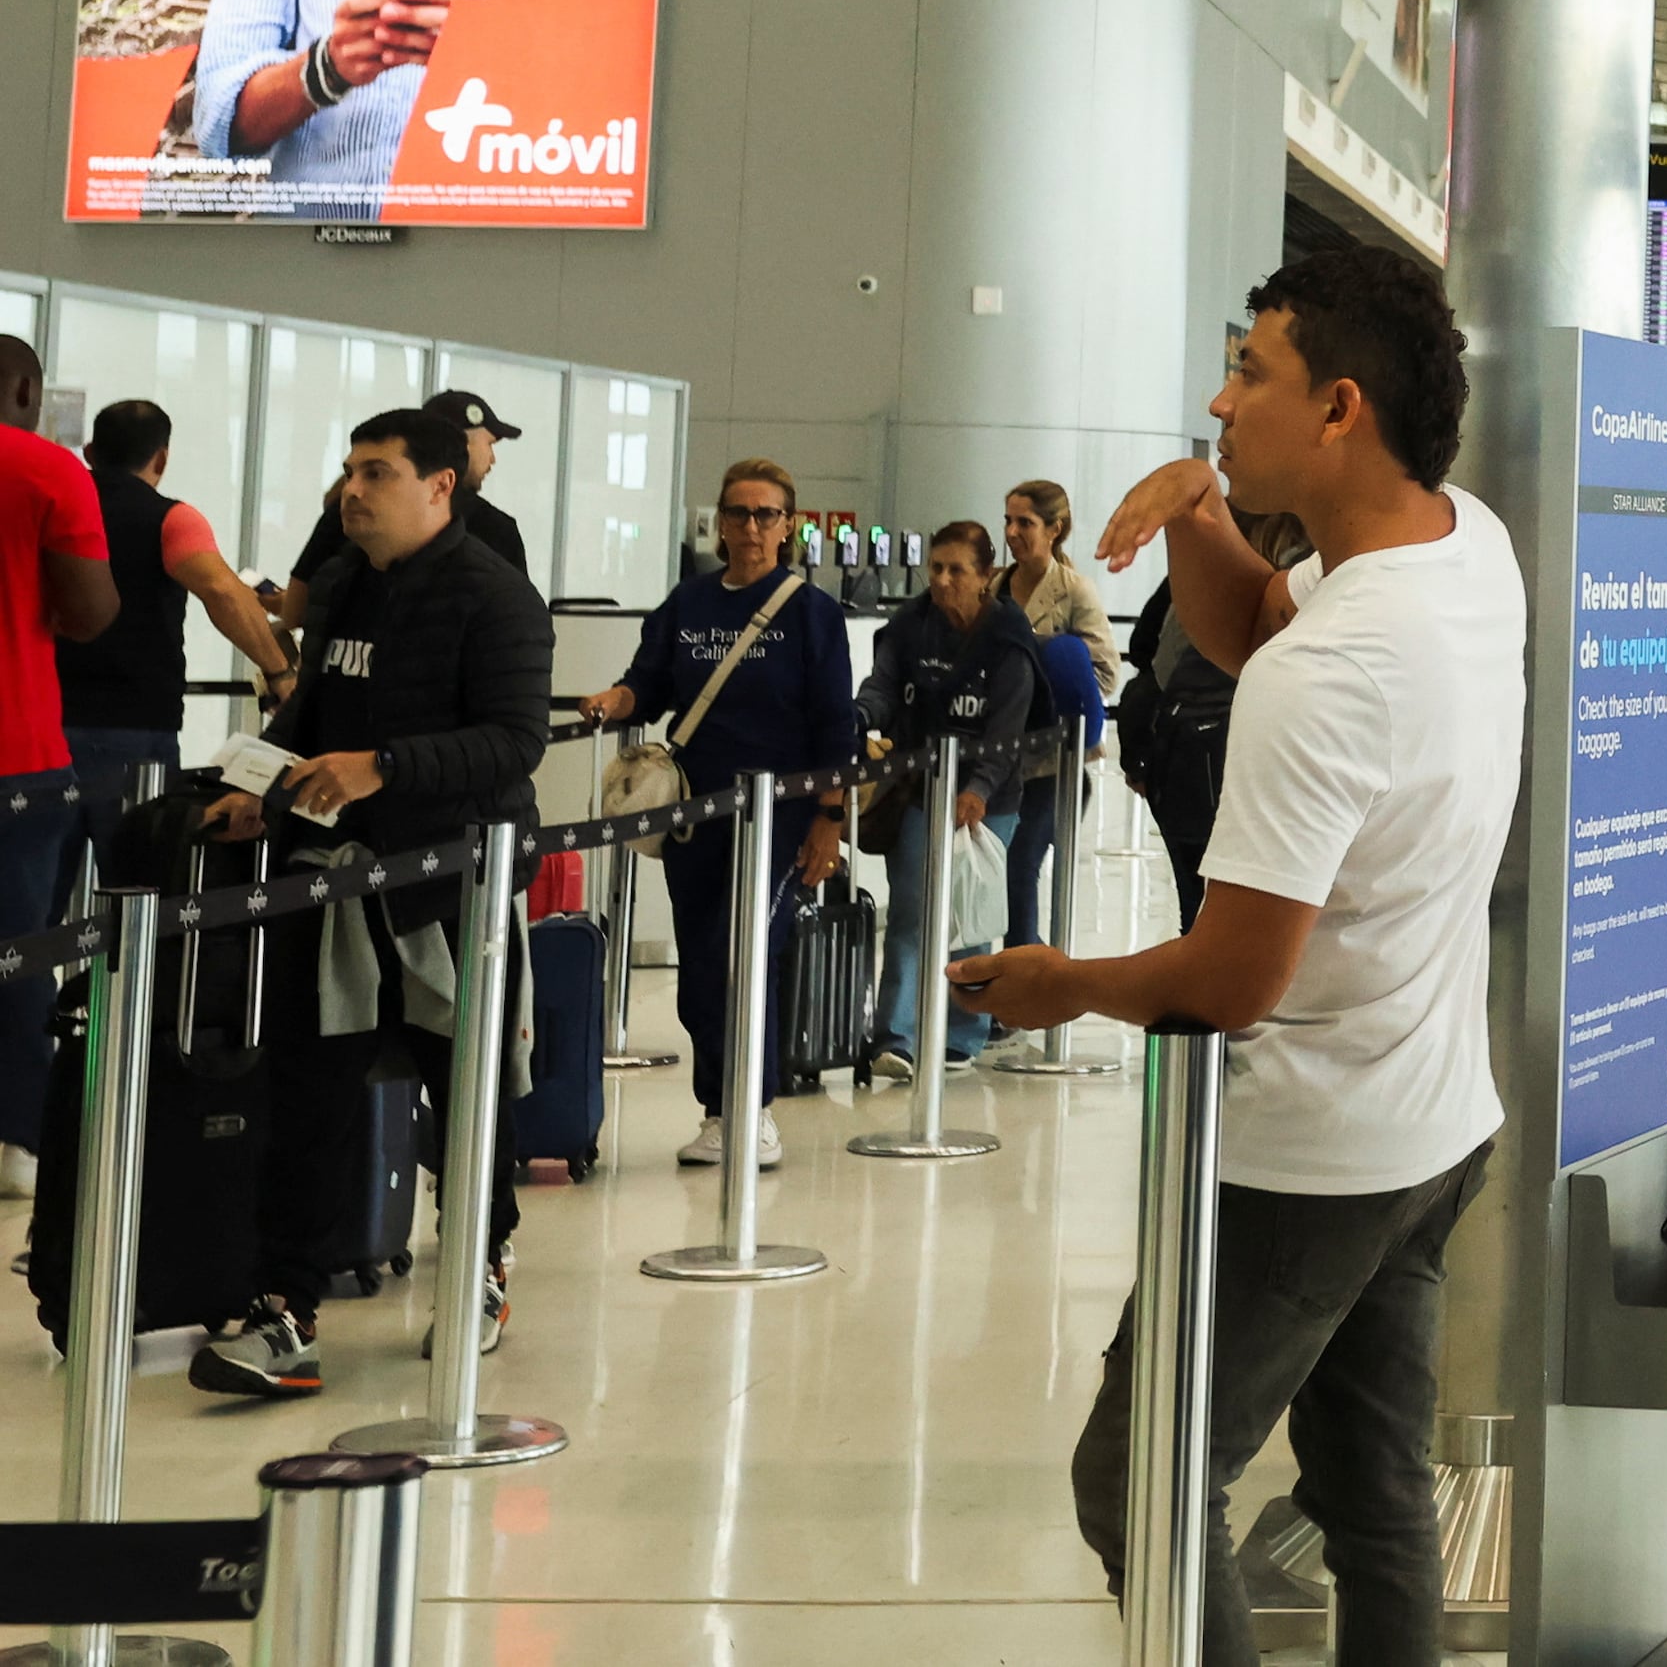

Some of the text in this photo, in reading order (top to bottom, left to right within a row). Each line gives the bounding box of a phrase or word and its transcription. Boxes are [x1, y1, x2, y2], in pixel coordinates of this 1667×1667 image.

[314, 225, 393, 245] JCDecaux
[1613, 494, 1667, 513] STAR ALLIANCE
[1581, 571, 1628, 611] Revisa
[1631, 571, 1644, 610] el
[679, 628, 706, 644] San
[1580, 630, 1599, 670] de
[1602, 634, 1617, 668] tu
[1578, 694, 1607, 721] Check
[1609, 694, 1624, 718] the
[1625, 692, 1641, 717] size
[1643, 690, 1654, 715] of
[1577, 729, 1622, 760] baggage.
[1575, 816, 1610, 840] Cualquier
[1611, 809, 1640, 836] equipaje
[1642, 809, 1655, 830] que
[1574, 845, 1602, 868] tamaño
[1603, 838, 1637, 867] permitido
[1638, 834, 1652, 854] será
[1573, 873, 1615, 898] en bodega.
